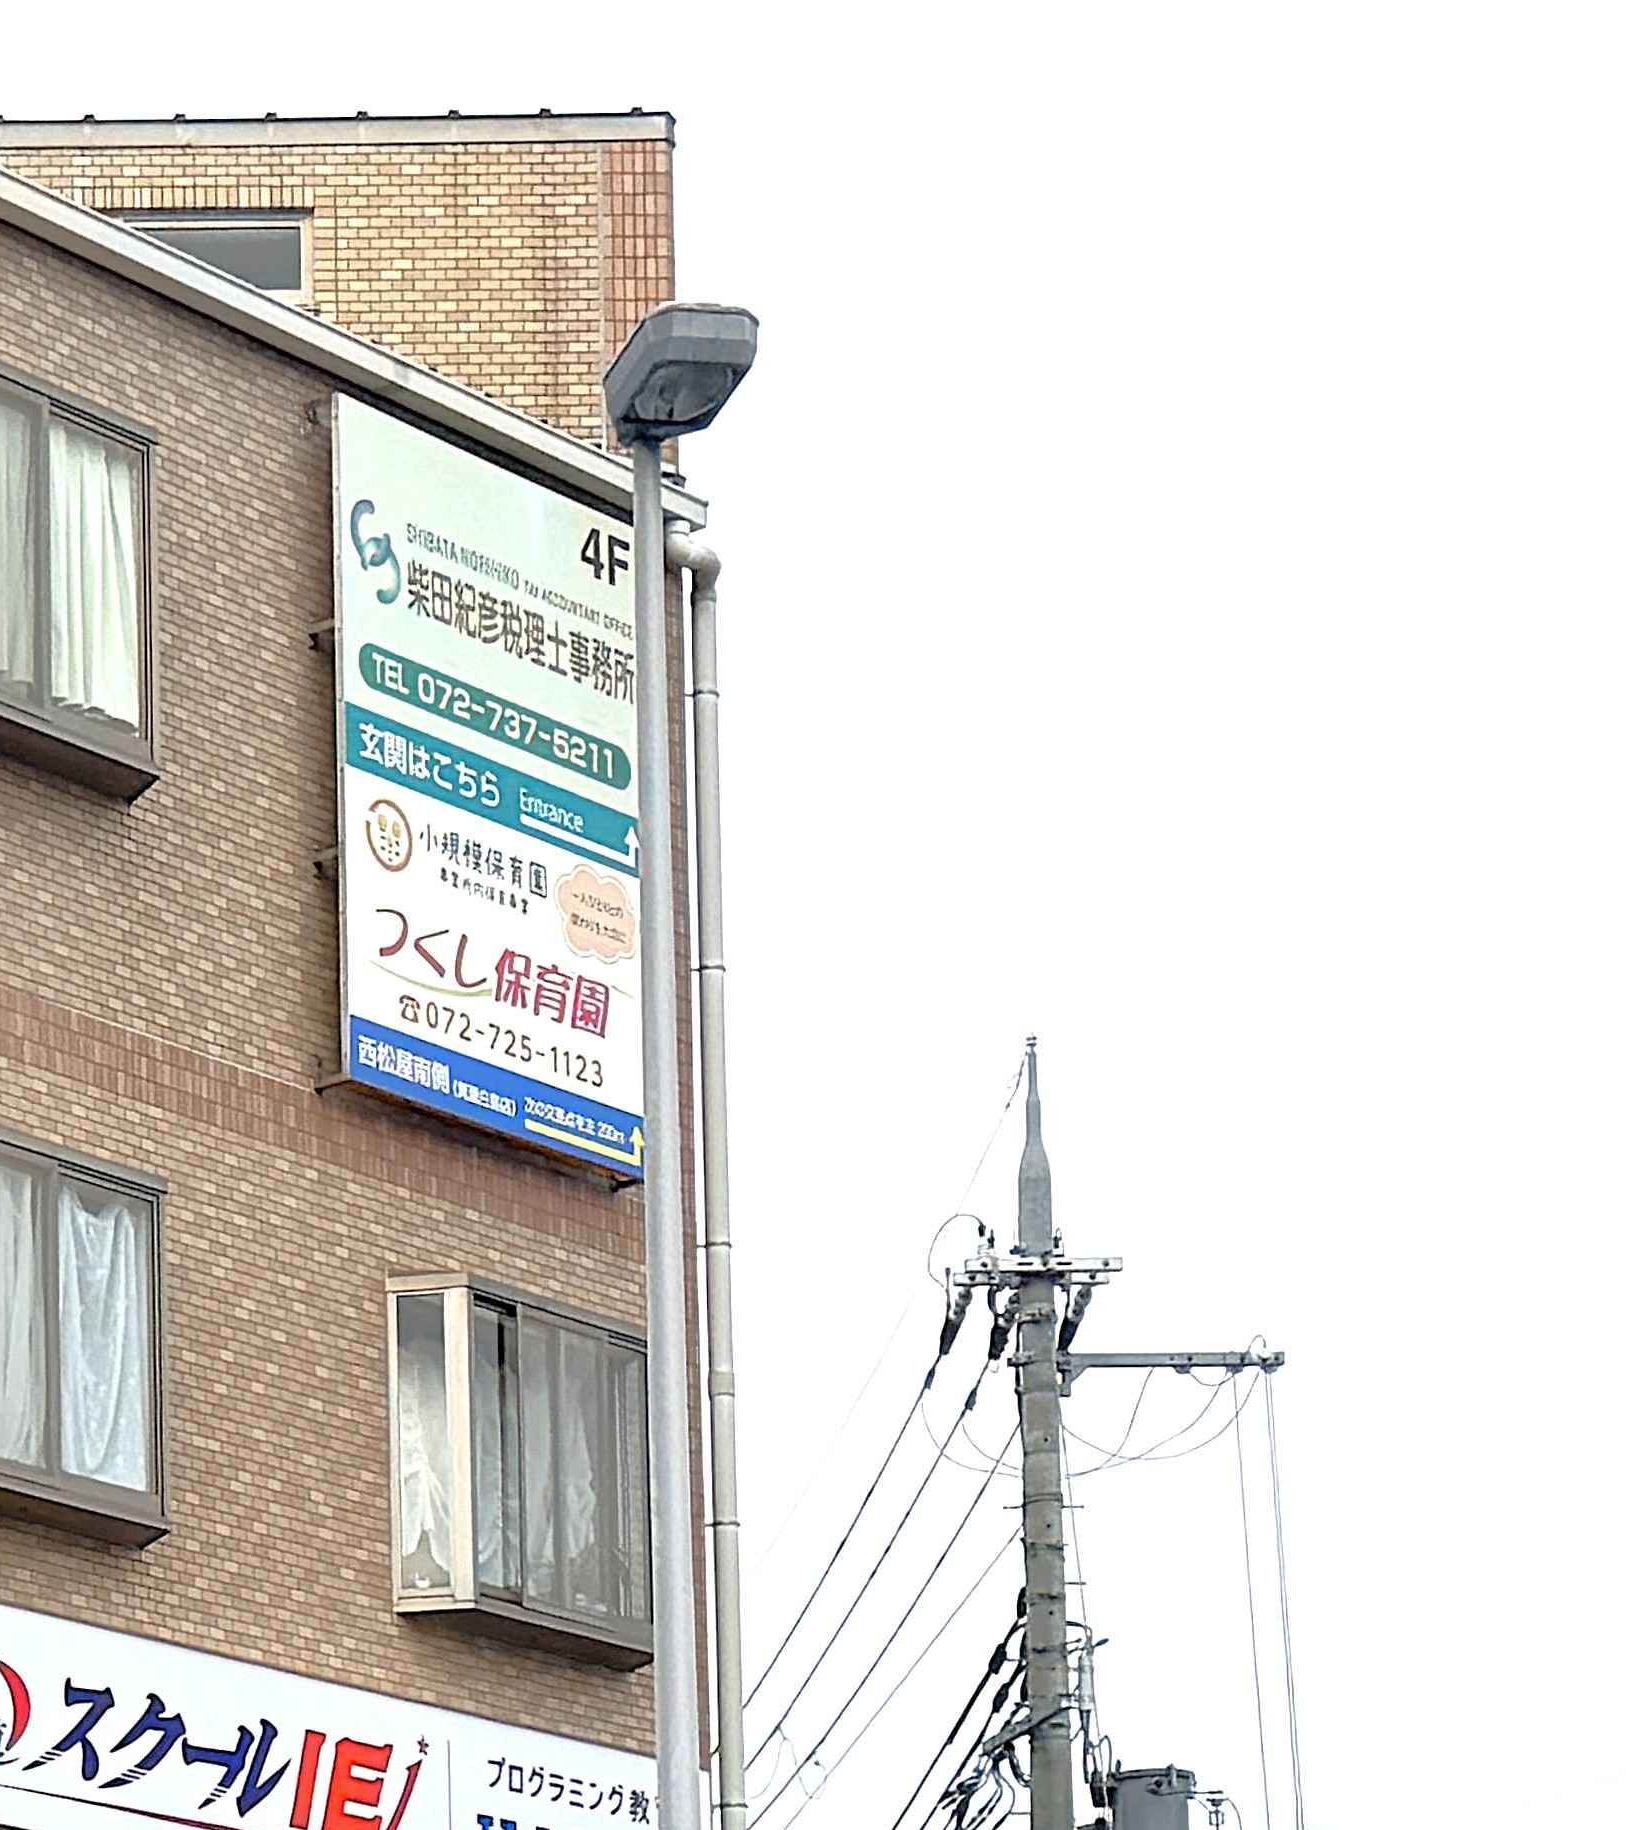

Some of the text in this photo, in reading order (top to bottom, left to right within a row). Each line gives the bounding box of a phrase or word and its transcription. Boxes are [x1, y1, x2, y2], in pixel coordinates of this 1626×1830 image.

[407, 523, 458, 564] SHIBATA
[581, 527, 630, 585] 4F
[407, 559, 634, 704] 柴田紀彦税理士事務所
[372, 653, 615, 779] TEL 072-737-5211
[359, 722, 500, 808] 玄関はこちら
[520, 787, 584, 833] Entrance
[418, 823, 547, 898] 小規模保育園
[376, 907, 611, 1039] つくし保育園
[427, 1001, 604, 1088] 072-725-1123
[488, 1757, 650, 1825] プログラミング教
